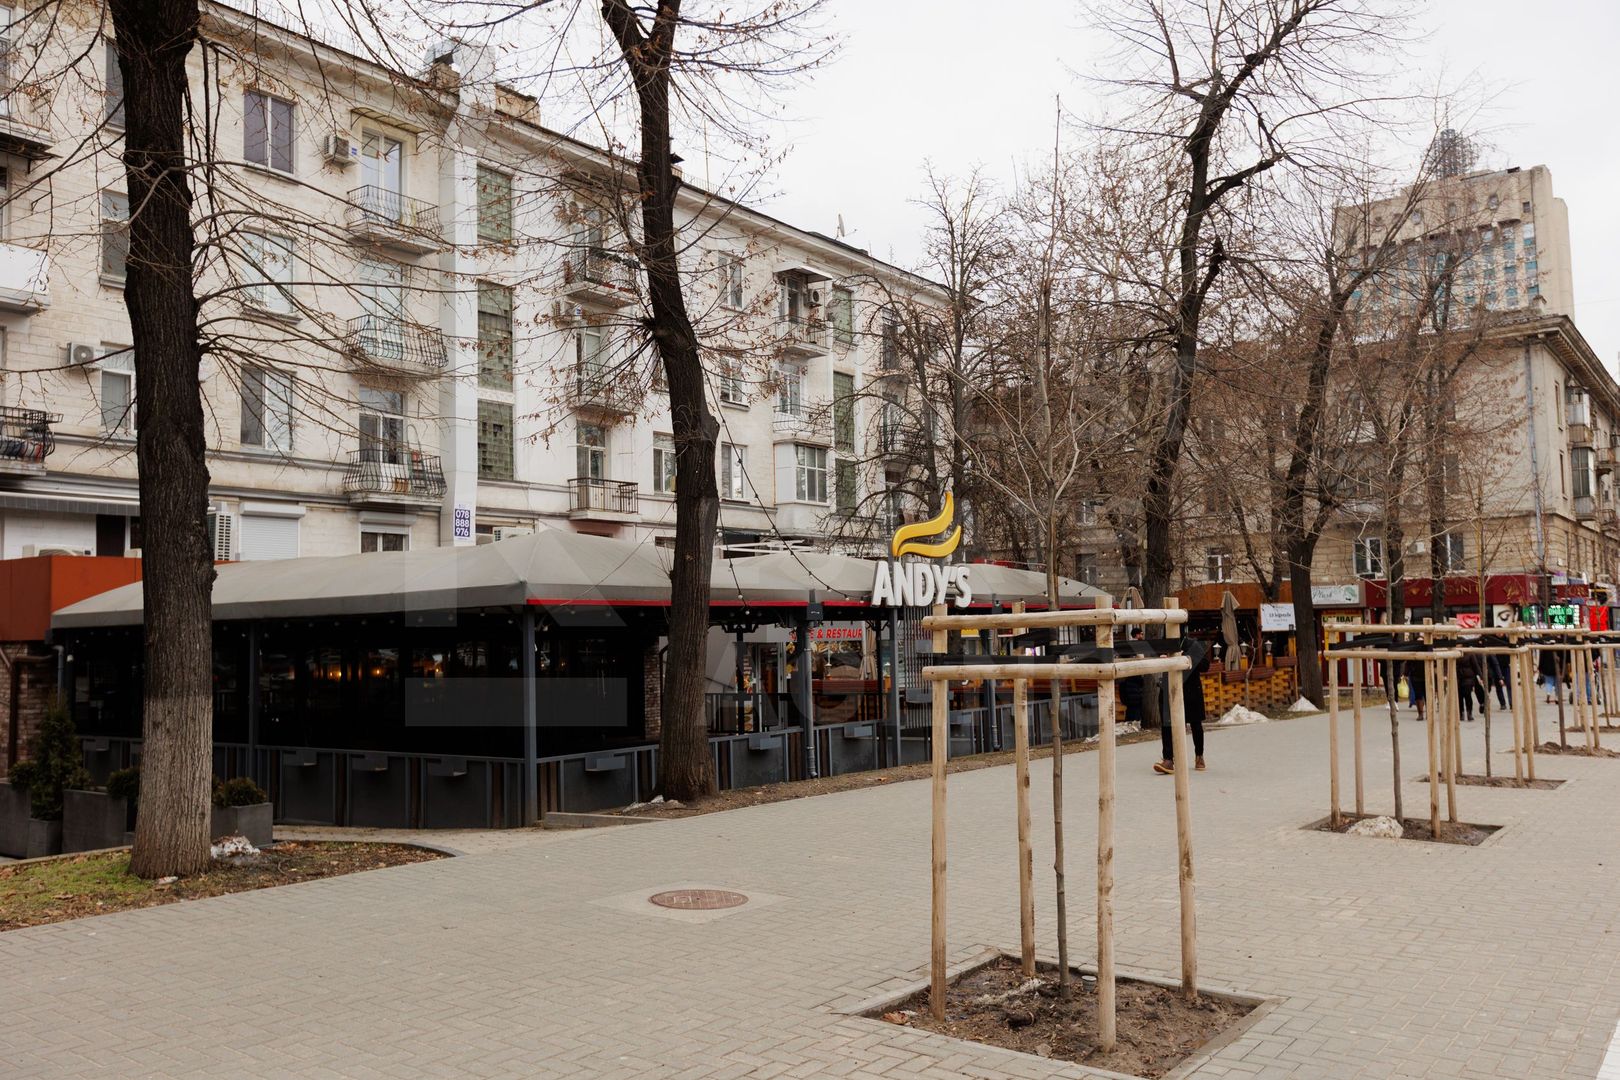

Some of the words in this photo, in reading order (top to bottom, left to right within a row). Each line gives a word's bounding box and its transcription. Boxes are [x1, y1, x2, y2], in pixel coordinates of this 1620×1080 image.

[456, 510, 470, 518] 078
[456, 519, 470, 527] 888
[456, 528, 468, 536] 976
[871, 560, 973, 609] ANDY'S
[817, 628, 824, 639] &
